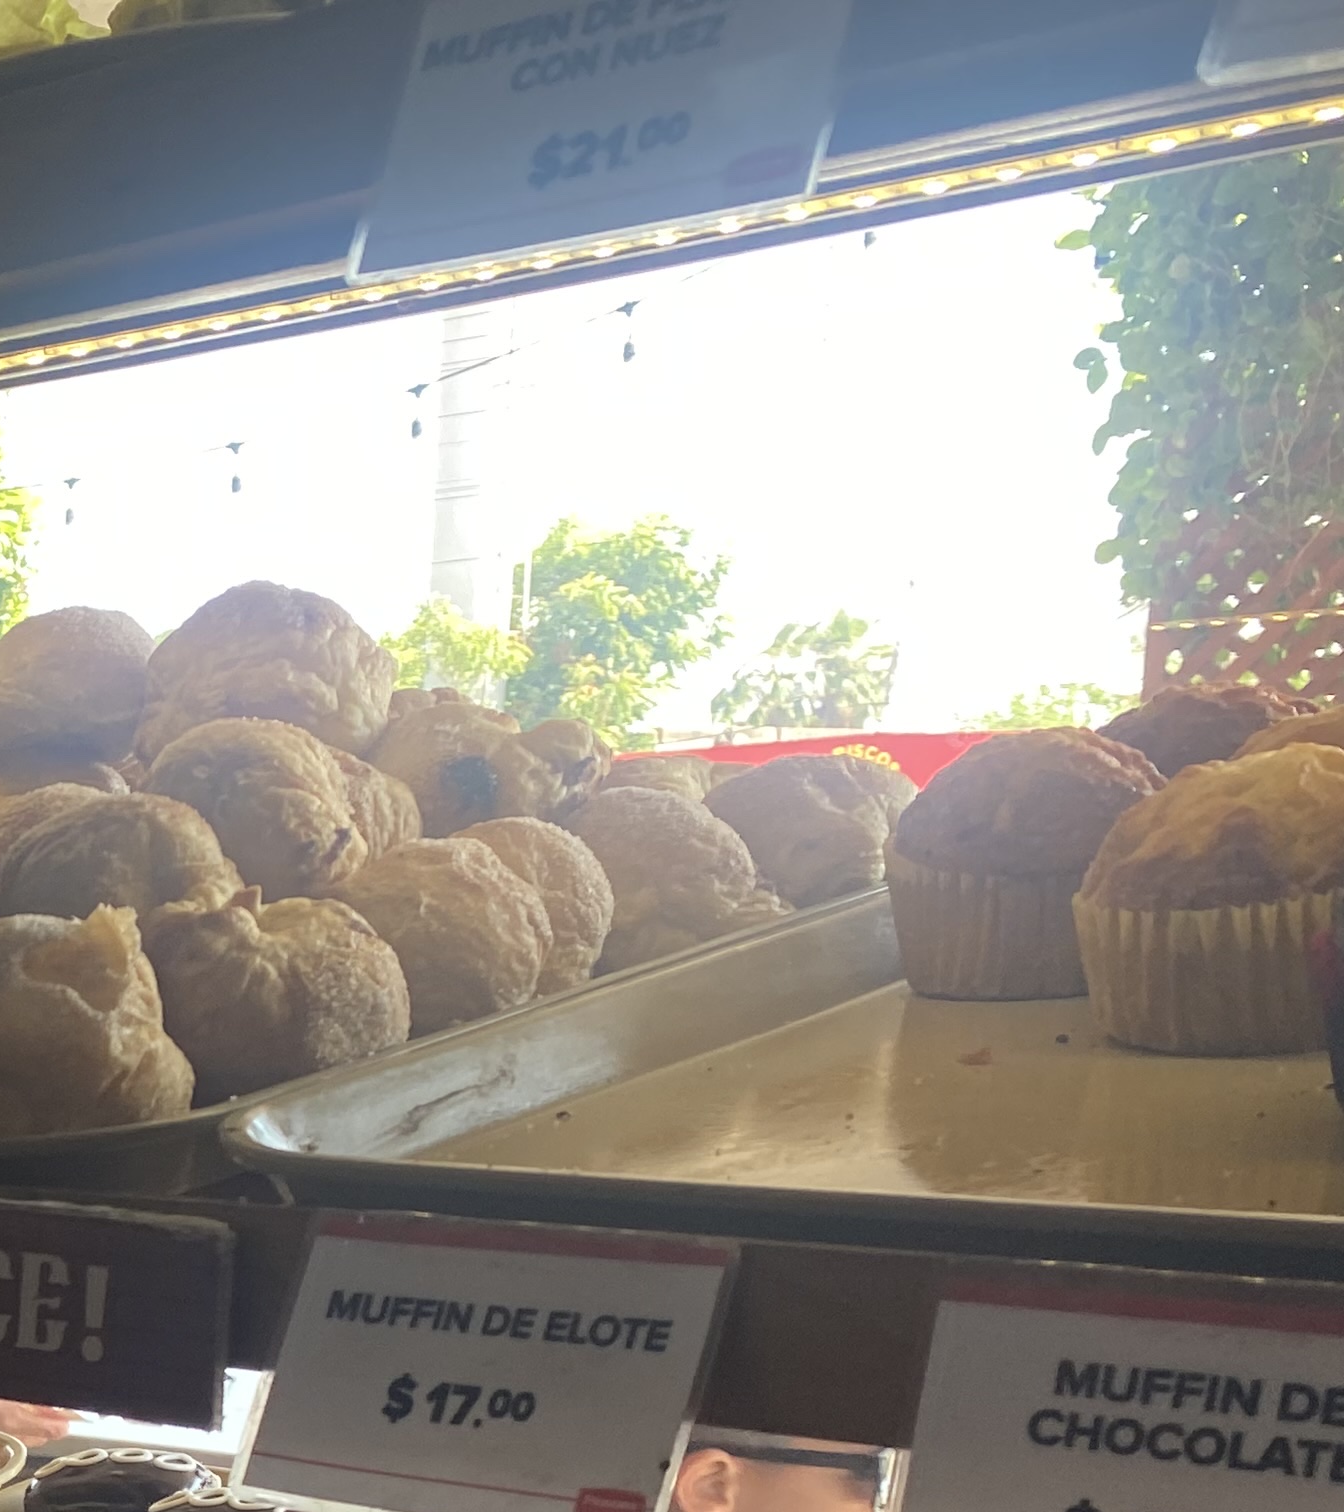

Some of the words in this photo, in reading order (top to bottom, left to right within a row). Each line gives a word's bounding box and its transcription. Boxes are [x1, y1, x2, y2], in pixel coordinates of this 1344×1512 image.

[421, 10, 574, 72] MUFFIN
[512, 42, 601, 92] CON
[612, 12, 727, 68] NUEZ
[325, 1289, 475, 1336] MUFFIN
[481, 1303, 538, 1340] DE
[542, 1309, 674, 1353] ELOTE
[1053, 1358, 1263, 1417] MUFFIN
[1277, 1381, 1344, 1427] DE
